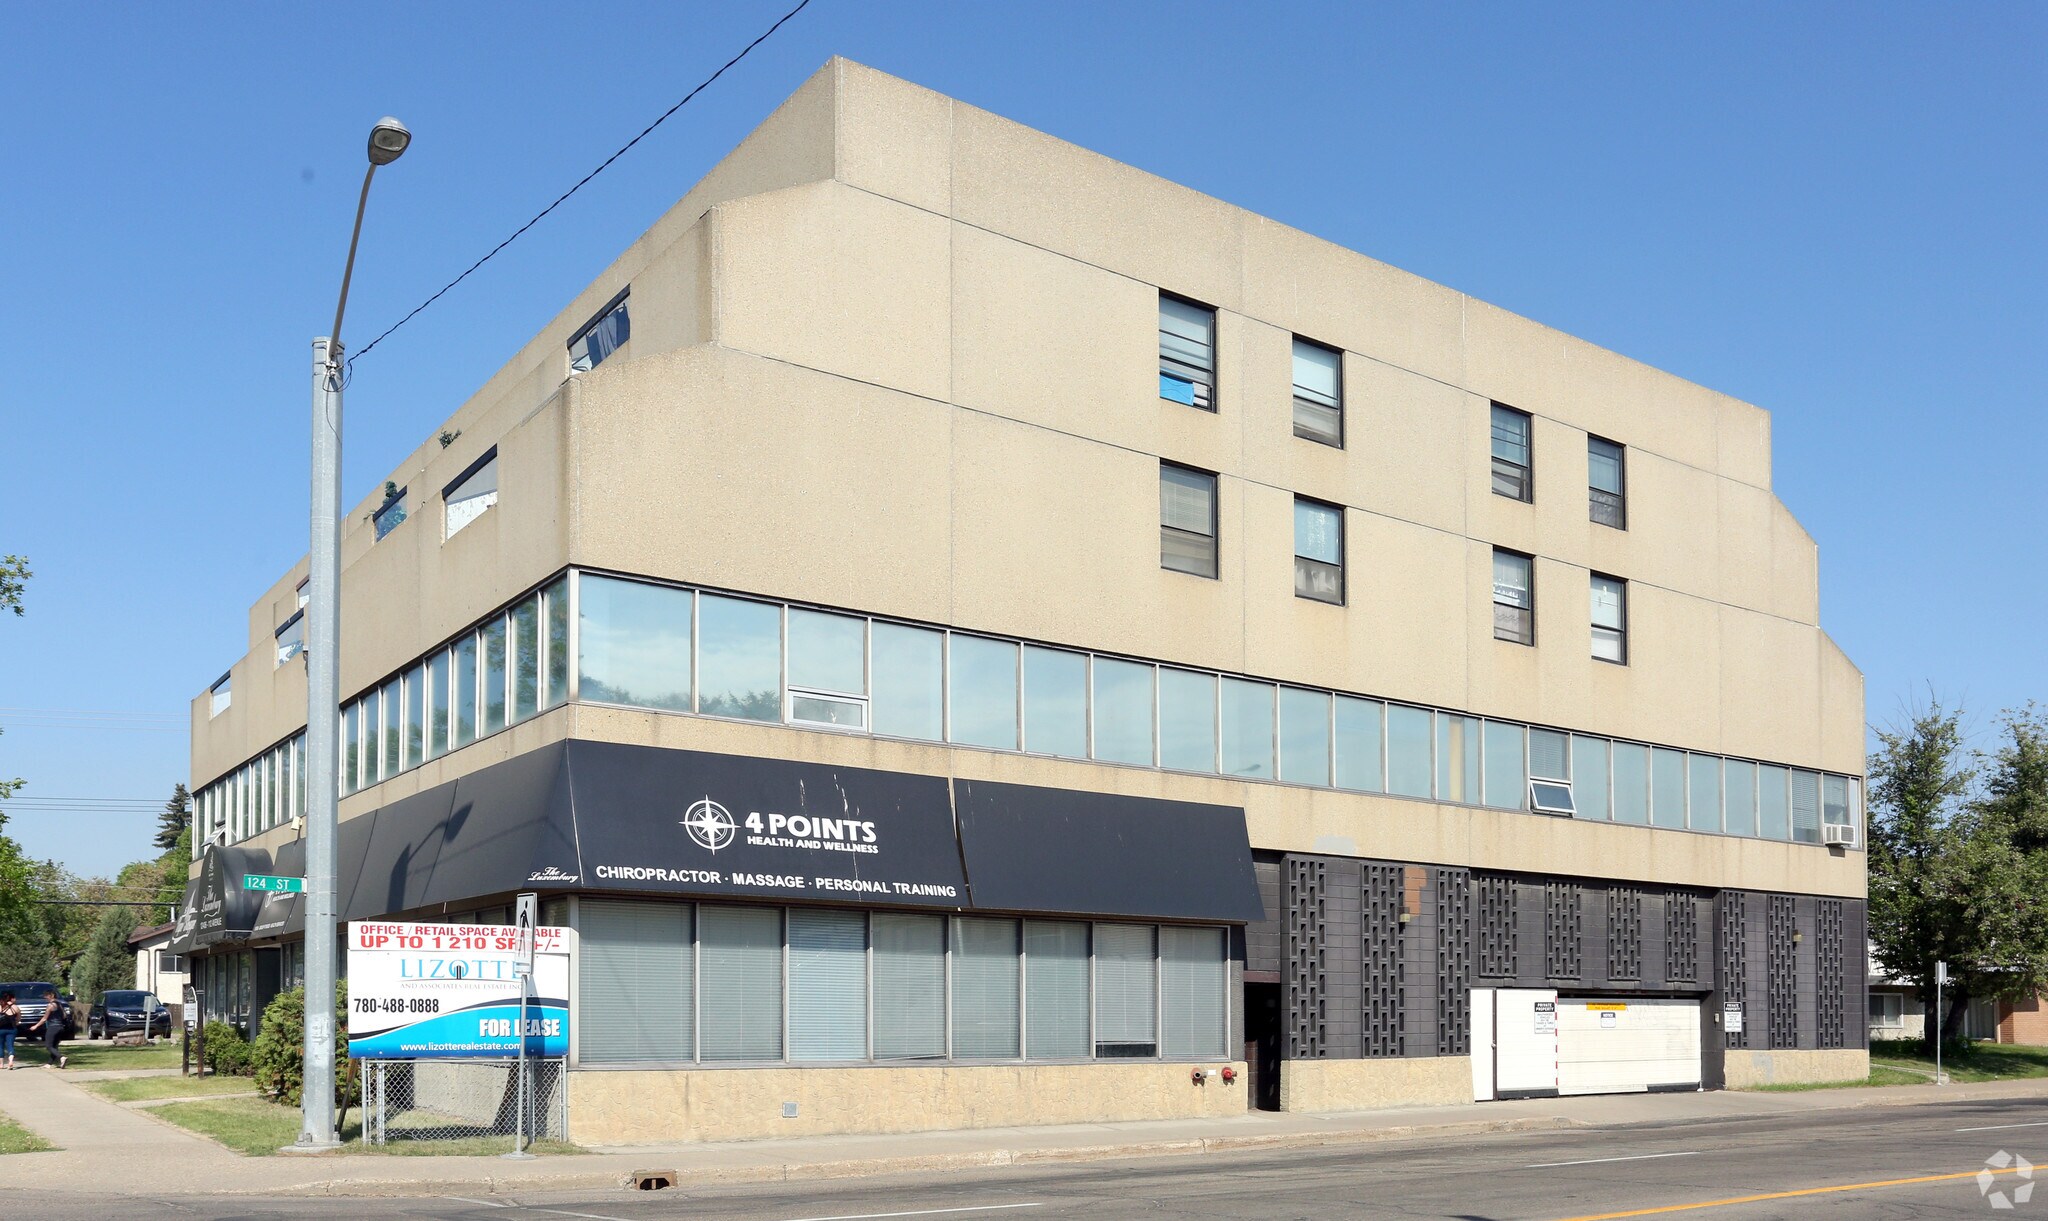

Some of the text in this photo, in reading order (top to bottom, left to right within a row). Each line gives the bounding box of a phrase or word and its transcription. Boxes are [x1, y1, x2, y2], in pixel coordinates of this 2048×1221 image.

[745, 812, 877, 843] 4 POINTS
[747, 835, 879, 854] HEALTH AND WELLNESS
[542, 866, 560, 876] The
[248, 877, 290, 890] 124 ST
[595, 865, 957, 898] CHIROPRACTOR MASSAGE PERSONAL TRAINING
[360, 924, 561, 938] OFFICE / RETAIL SPACE AVABLE
[360, 935, 389, 949] UP
[396, 935, 423, 949] TO
[495, 937, 516, 950] SF
[354, 998, 440, 1013] 780-488-0888
[479, 1018, 561, 1037] FOR LEASE
